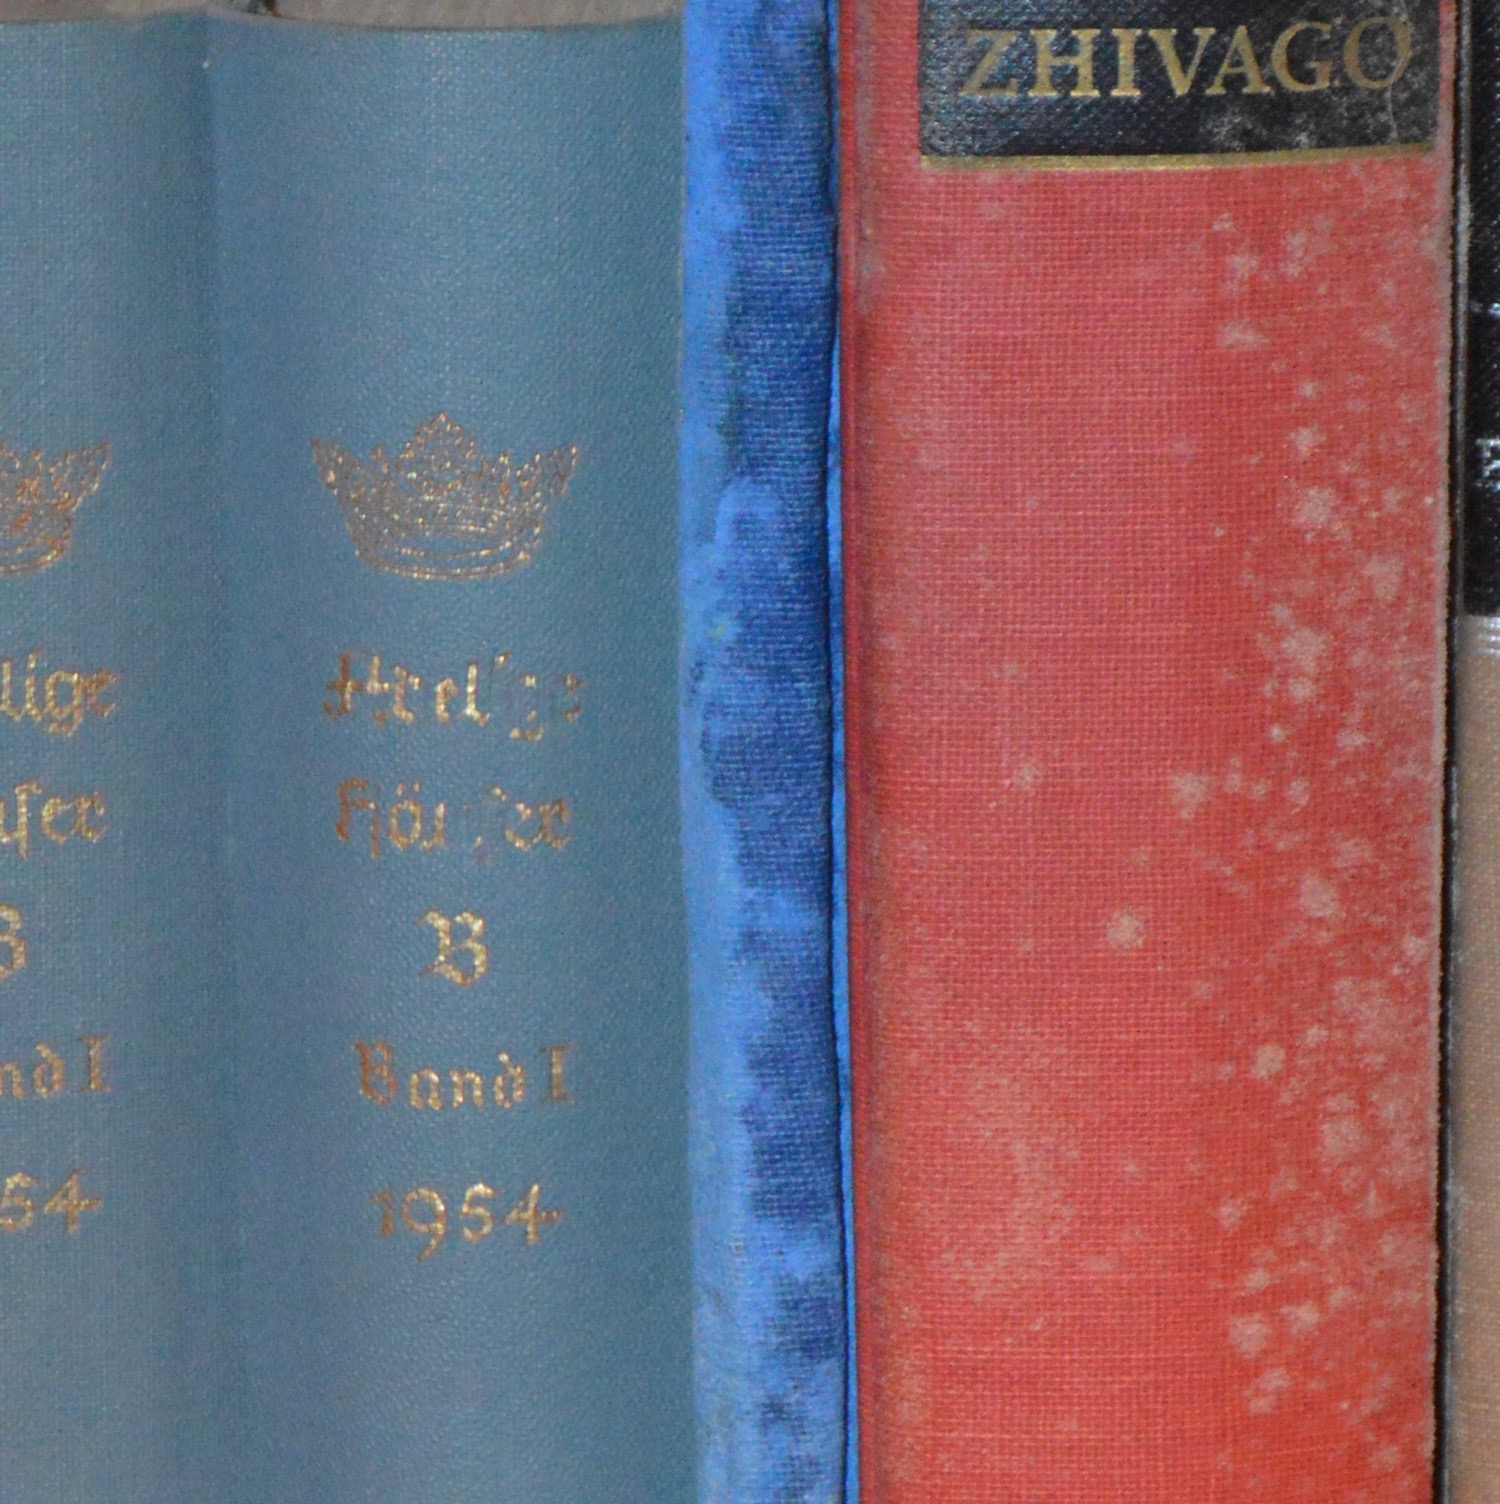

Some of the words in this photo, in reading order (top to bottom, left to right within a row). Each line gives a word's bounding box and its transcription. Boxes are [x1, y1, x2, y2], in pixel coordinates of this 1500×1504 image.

[958, 16, 1412, 97] ZHIVAGO
[418, 907, 491, 987] B
[354, 1040, 529, 1111] Band
[541, 1041, 578, 1107] I
[370, 1179, 564, 1264] 1954
